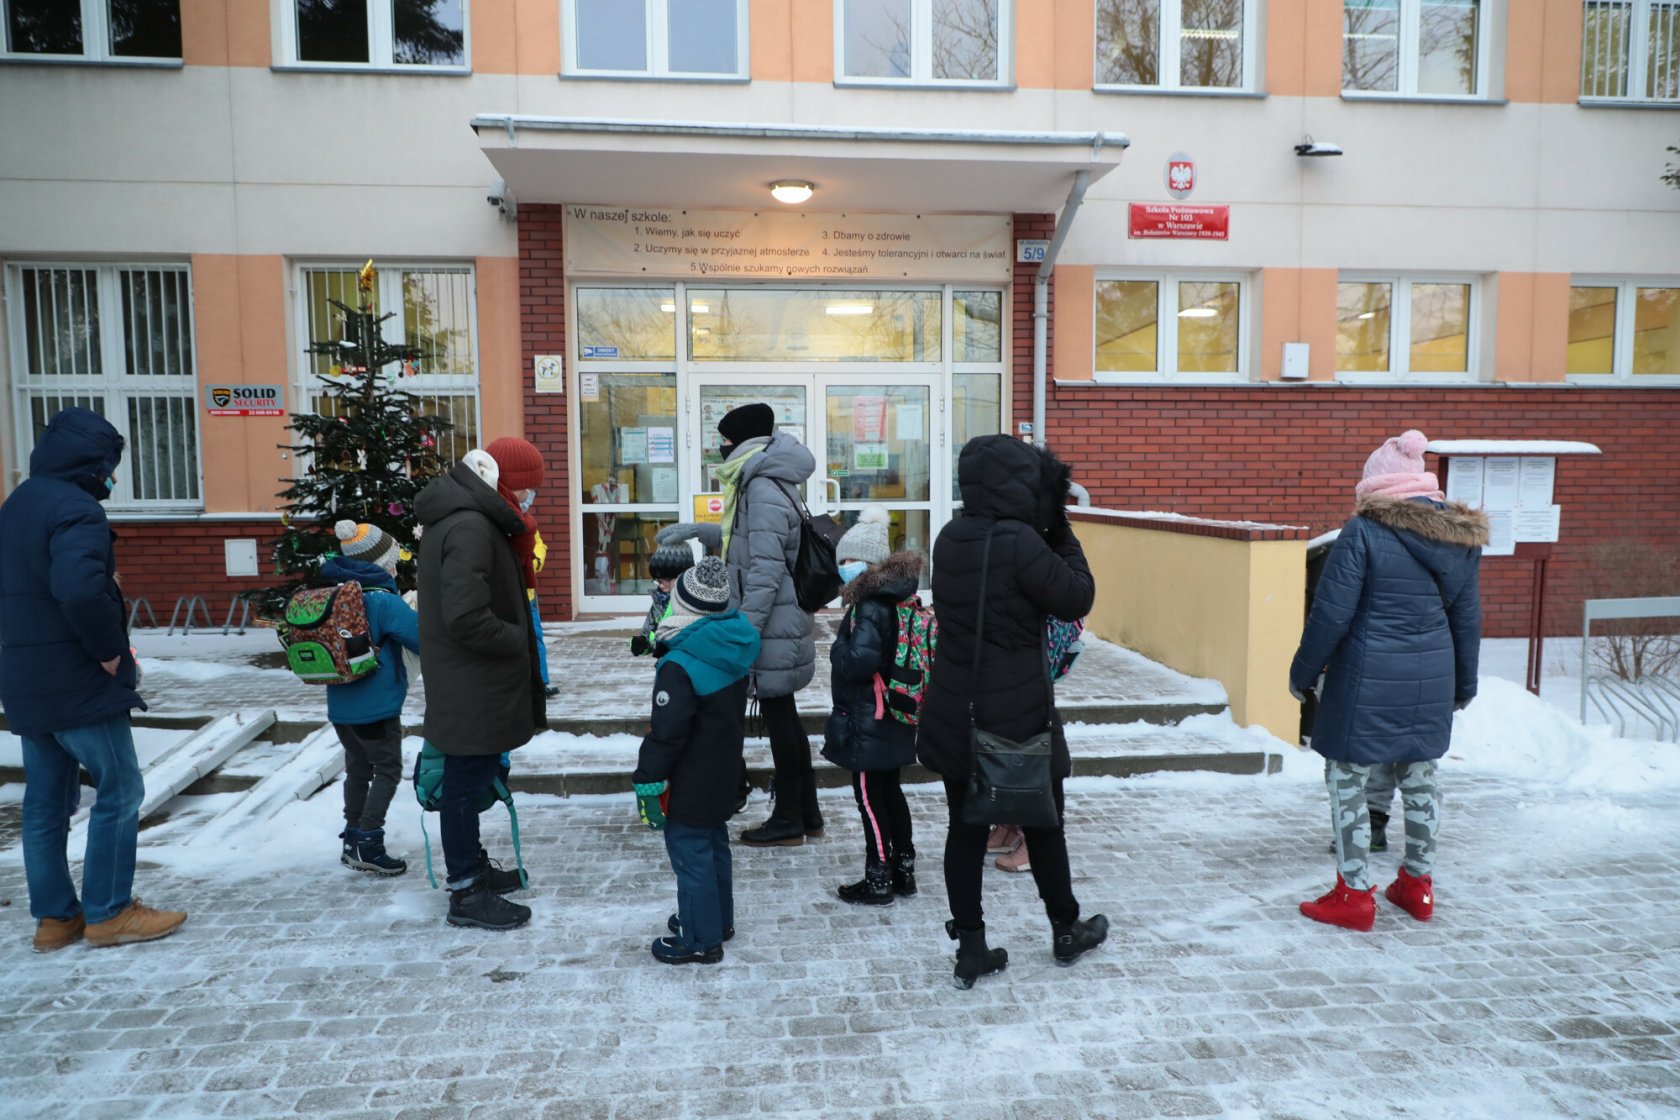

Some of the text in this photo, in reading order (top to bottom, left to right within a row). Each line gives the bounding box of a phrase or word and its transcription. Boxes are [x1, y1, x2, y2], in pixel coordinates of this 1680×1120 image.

[574, 208, 672, 223] W naszej szkole:
[1166, 221, 1204, 230] Warszawie
[635, 227, 740, 240] 1. Wiemy, jak się uczyć
[822, 231, 830, 240] 3.
[833, 231, 864, 242] Dbamy
[876, 232, 910, 241] zdrowie
[634, 243, 642, 252] 2.
[645, 244, 682, 255] Uczymy
[685, 244, 698, 256] się
[711, 246, 757, 257] przyjaznej
[760, 247, 810, 257] atmosferze
[822, 248, 830, 256] 4.
[833, 248, 875, 259] Jesteśmy
[878, 249, 929, 260] tolerancyjni
[936, 250, 968, 259] otwarci
[983, 250, 1006, 259] świat
[1024, 247, 1045, 260] 5/9
[744, 264, 784, 274] szukamy
[786, 265, 820, 274] nowych
[823, 265, 868, 275] rozwiązań
[233, 388, 276, 398] SOLID
